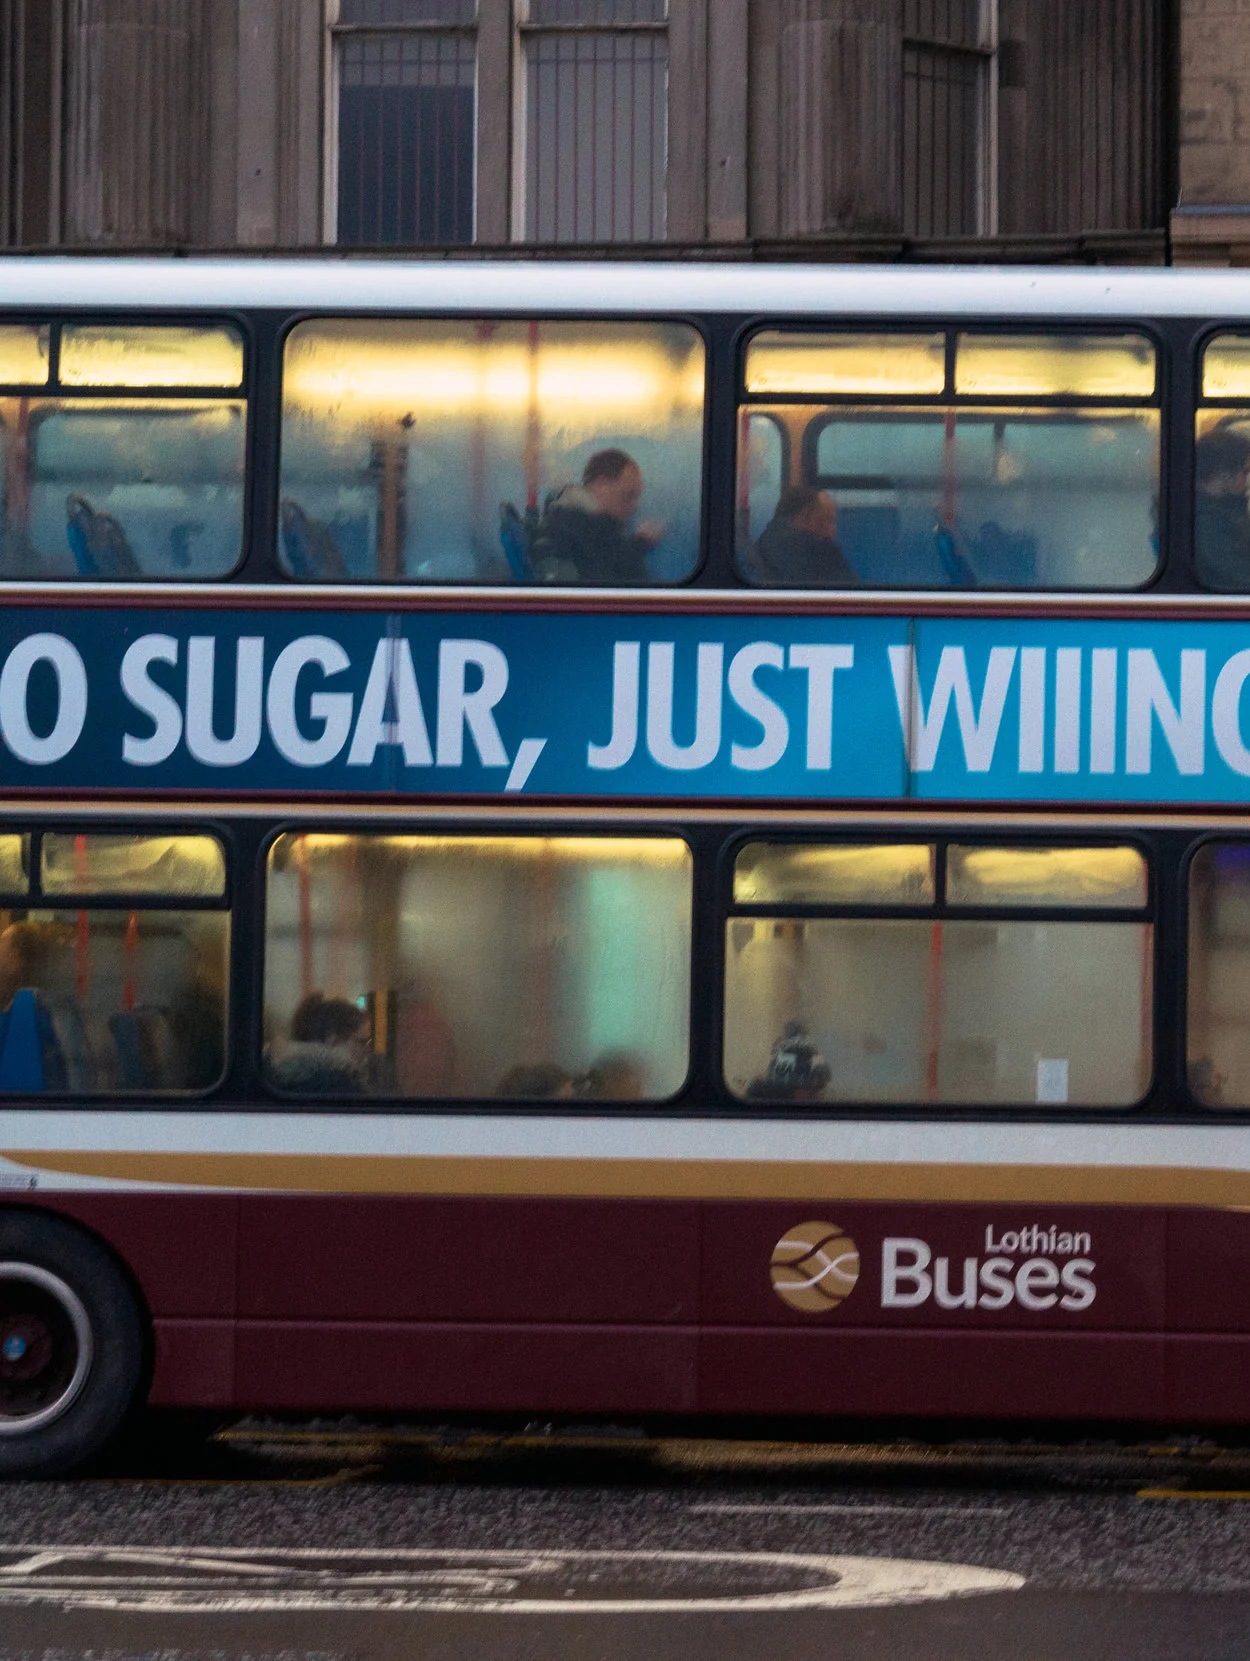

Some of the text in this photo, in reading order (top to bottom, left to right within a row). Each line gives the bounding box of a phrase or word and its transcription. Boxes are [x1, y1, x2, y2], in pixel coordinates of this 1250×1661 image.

[119, 632, 546, 793] SUGAR,
[586, 640, 855, 772] JUST
[880, 1236, 1098, 1312] Buses
[984, 1223, 1092, 1255] Lothian
